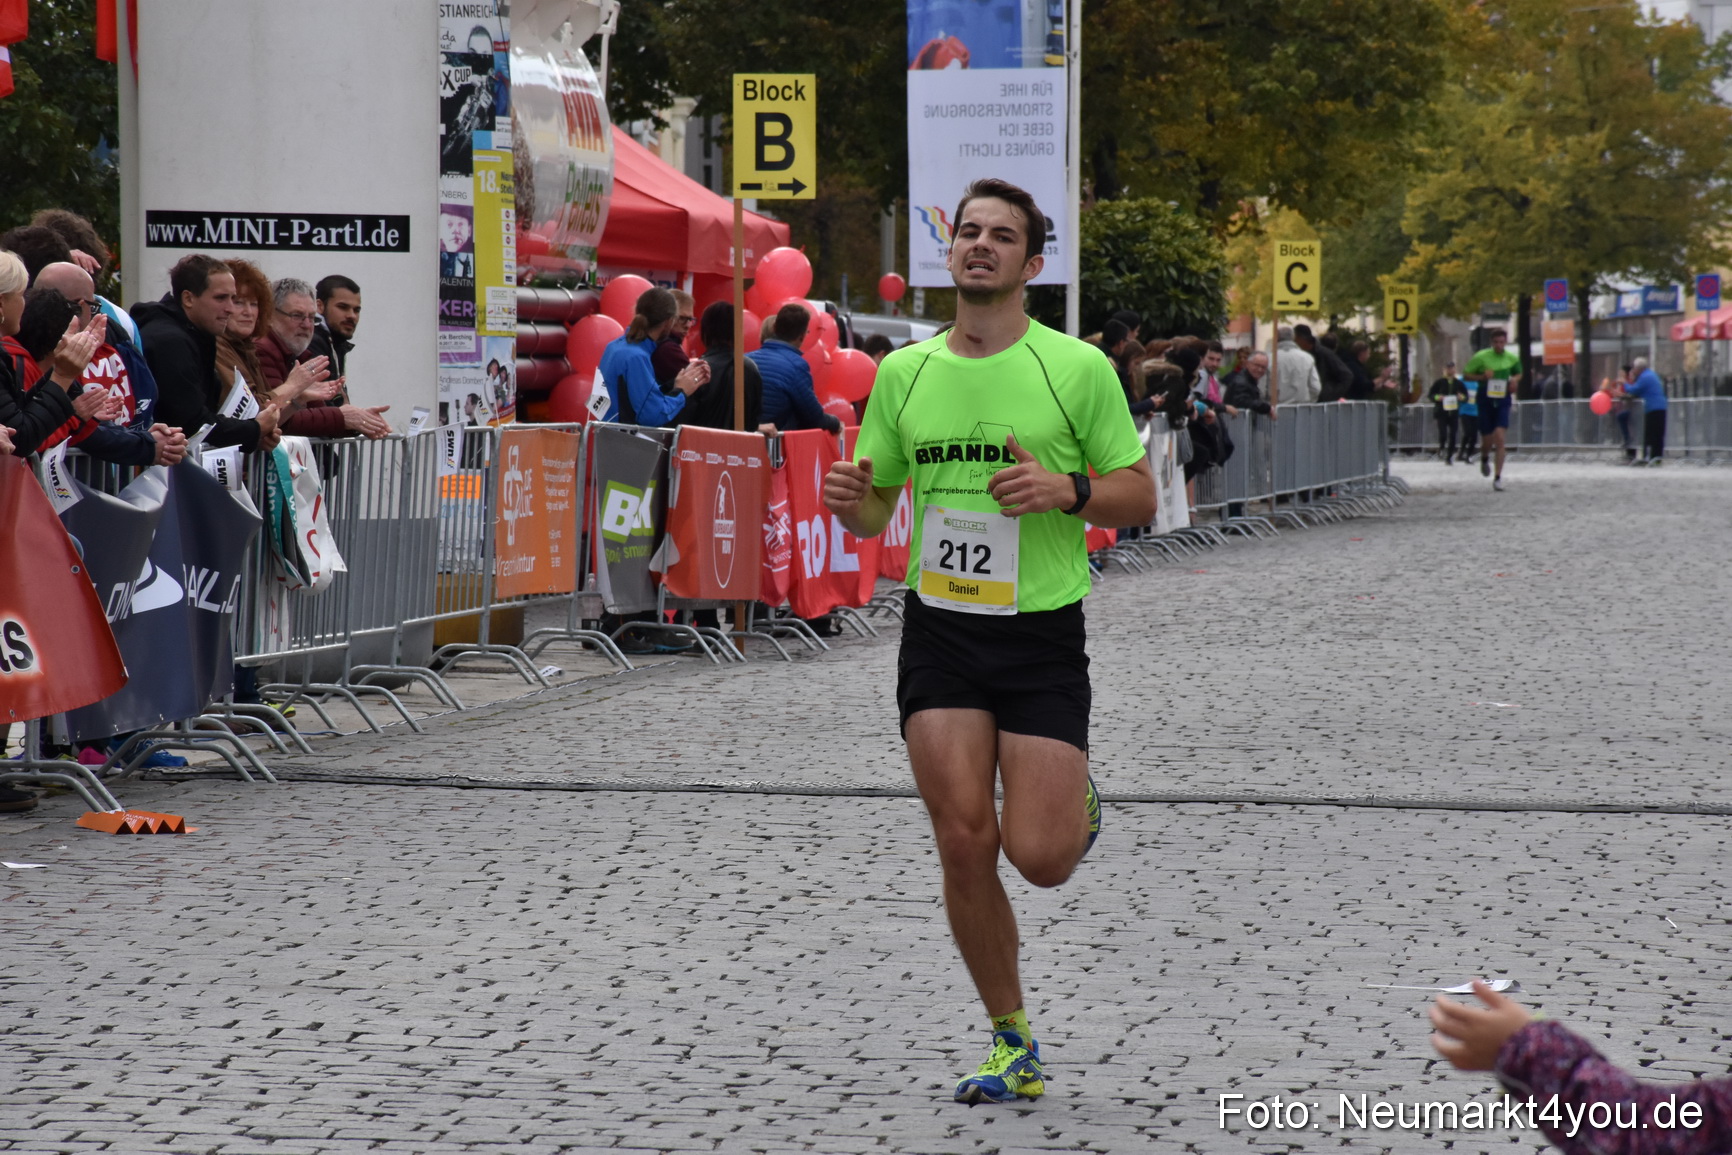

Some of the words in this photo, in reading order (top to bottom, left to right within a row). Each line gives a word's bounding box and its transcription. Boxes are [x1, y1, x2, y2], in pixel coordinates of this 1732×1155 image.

[440, 69, 456, 91] X
[454, 68, 471, 83] CUP
[743, 79, 806, 101] Block
[755, 112, 795, 171] B
[477, 169, 501, 193] 18.
[440, 190, 467, 200] NBERG
[147, 217, 400, 248] www.MINI-Partl.de
[1279, 244, 1315, 256] Block
[1285, 262, 1308, 295] C
[1388, 286, 1414, 295] Block
[1393, 300, 1409, 322] D
[915, 444, 1016, 466] BRANDL
[952, 519, 987, 531] BOCK
[939, 539, 992, 575] 212
[948, 581, 979, 596] Daniel
